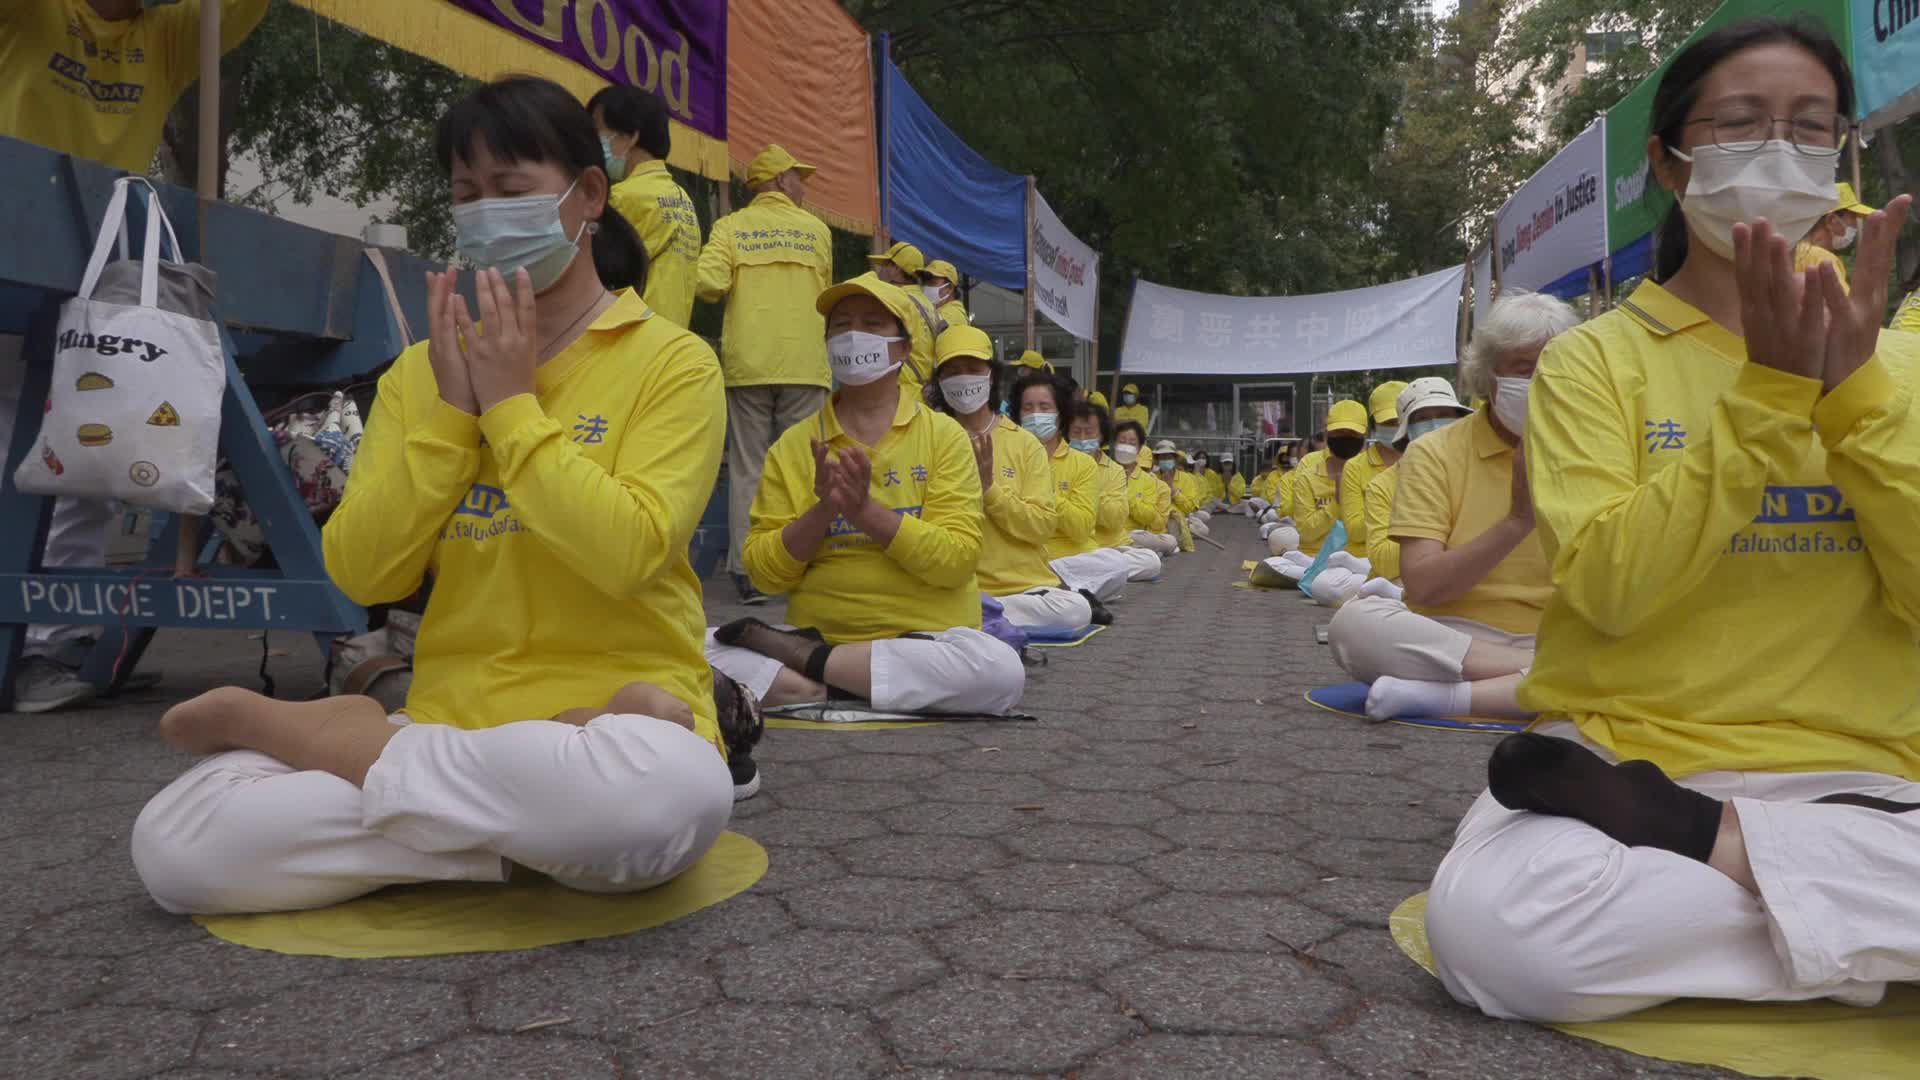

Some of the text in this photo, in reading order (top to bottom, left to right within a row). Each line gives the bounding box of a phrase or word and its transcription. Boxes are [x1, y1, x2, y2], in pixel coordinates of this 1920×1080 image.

[1554, 194, 1564, 225] to
[1564, 173, 1597, 218] Justice
[855, 352, 880, 365] CCP
[964, 385, 983, 396] CCP
[574, 414, 608, 443] 法
[1645, 419, 1686, 453] 法
[883, 464, 929, 487] 大法
[21, 580, 286, 621] POLICE DEPT.
